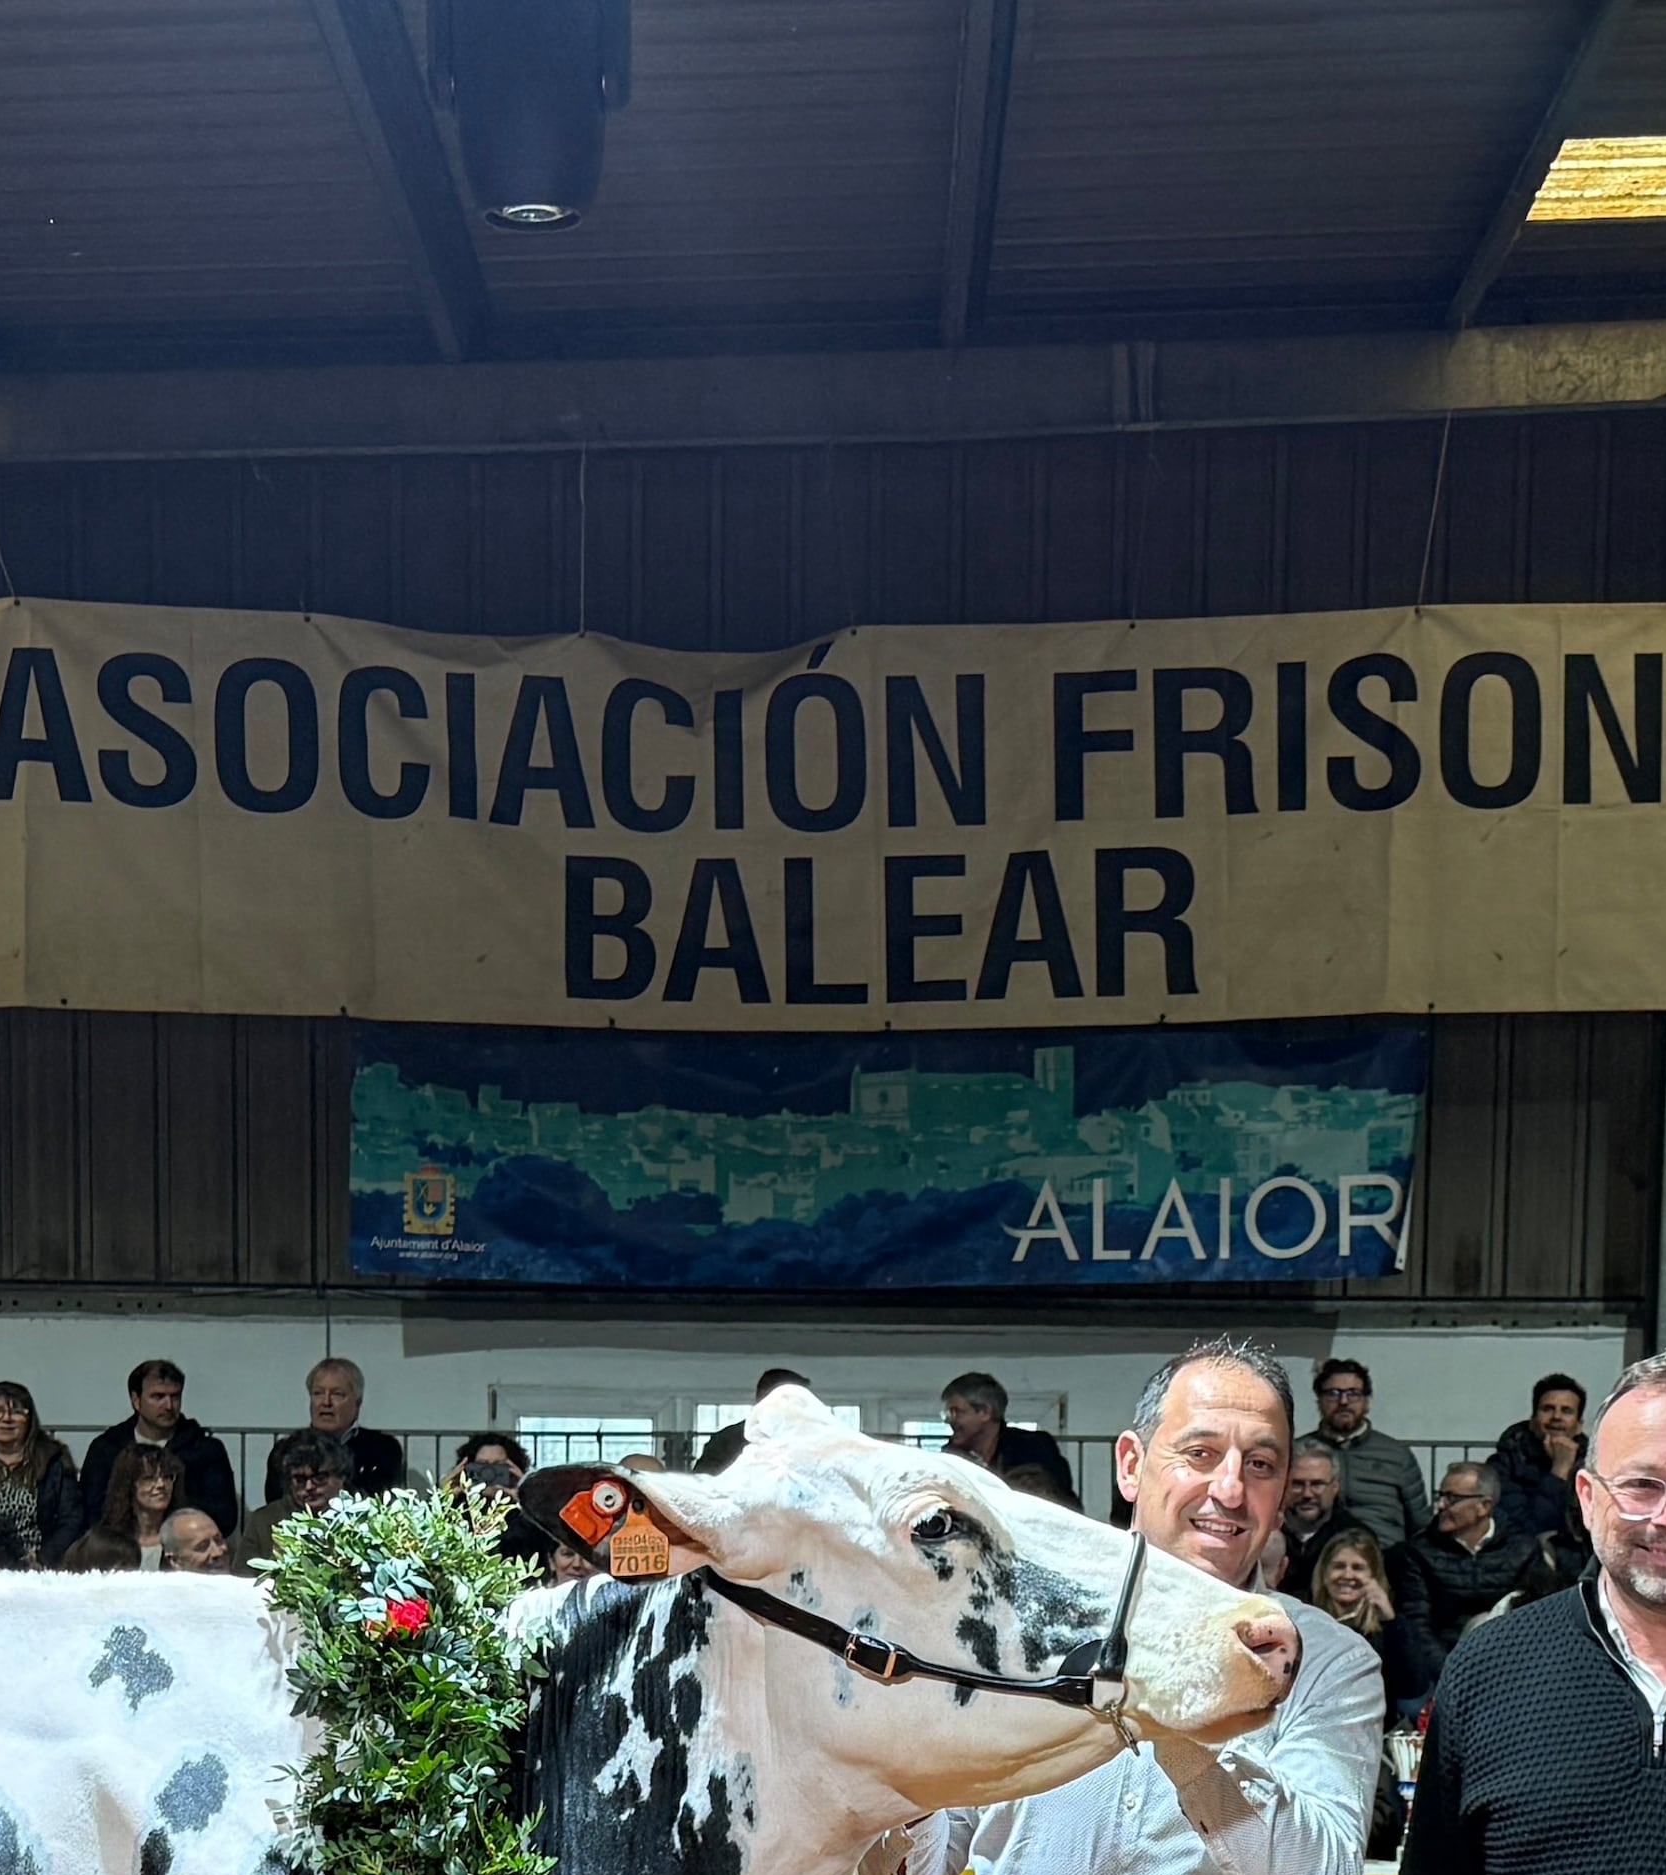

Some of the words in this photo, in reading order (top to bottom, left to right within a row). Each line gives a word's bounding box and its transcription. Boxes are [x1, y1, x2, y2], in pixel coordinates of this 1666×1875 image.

[564, 846, 1199, 1006] BALEAR
[371, 1235, 439, 1250] Ajuntament
[1001, 1174, 1405, 1263] ALAIOR
[613, 1554, 665, 1573] 7016
